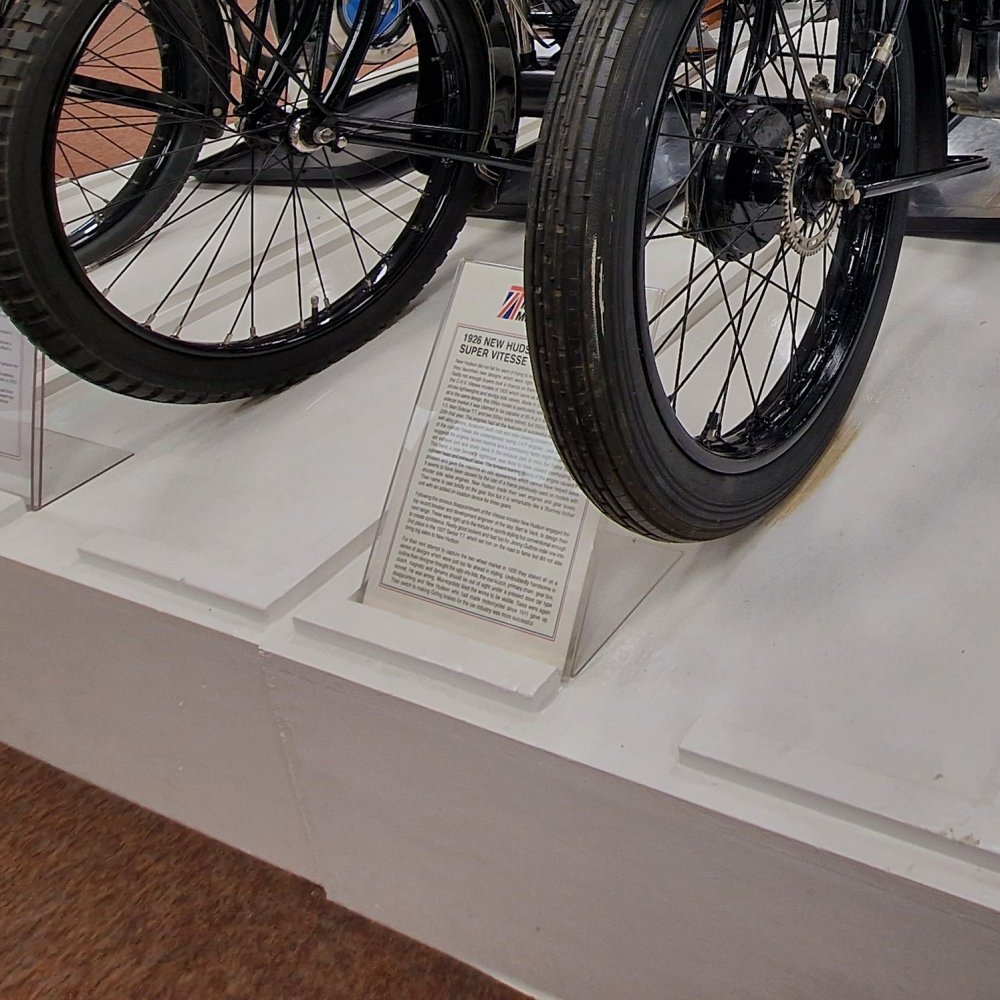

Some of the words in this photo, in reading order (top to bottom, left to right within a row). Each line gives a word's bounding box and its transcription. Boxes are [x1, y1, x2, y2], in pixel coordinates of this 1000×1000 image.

[459, 343, 490, 358] SUPER
[491, 350, 529, 366] VITESSE
[463, 333, 482, 345] 1926
[484, 337, 505, 349] NEW
[506, 341, 530, 355] HUDS
